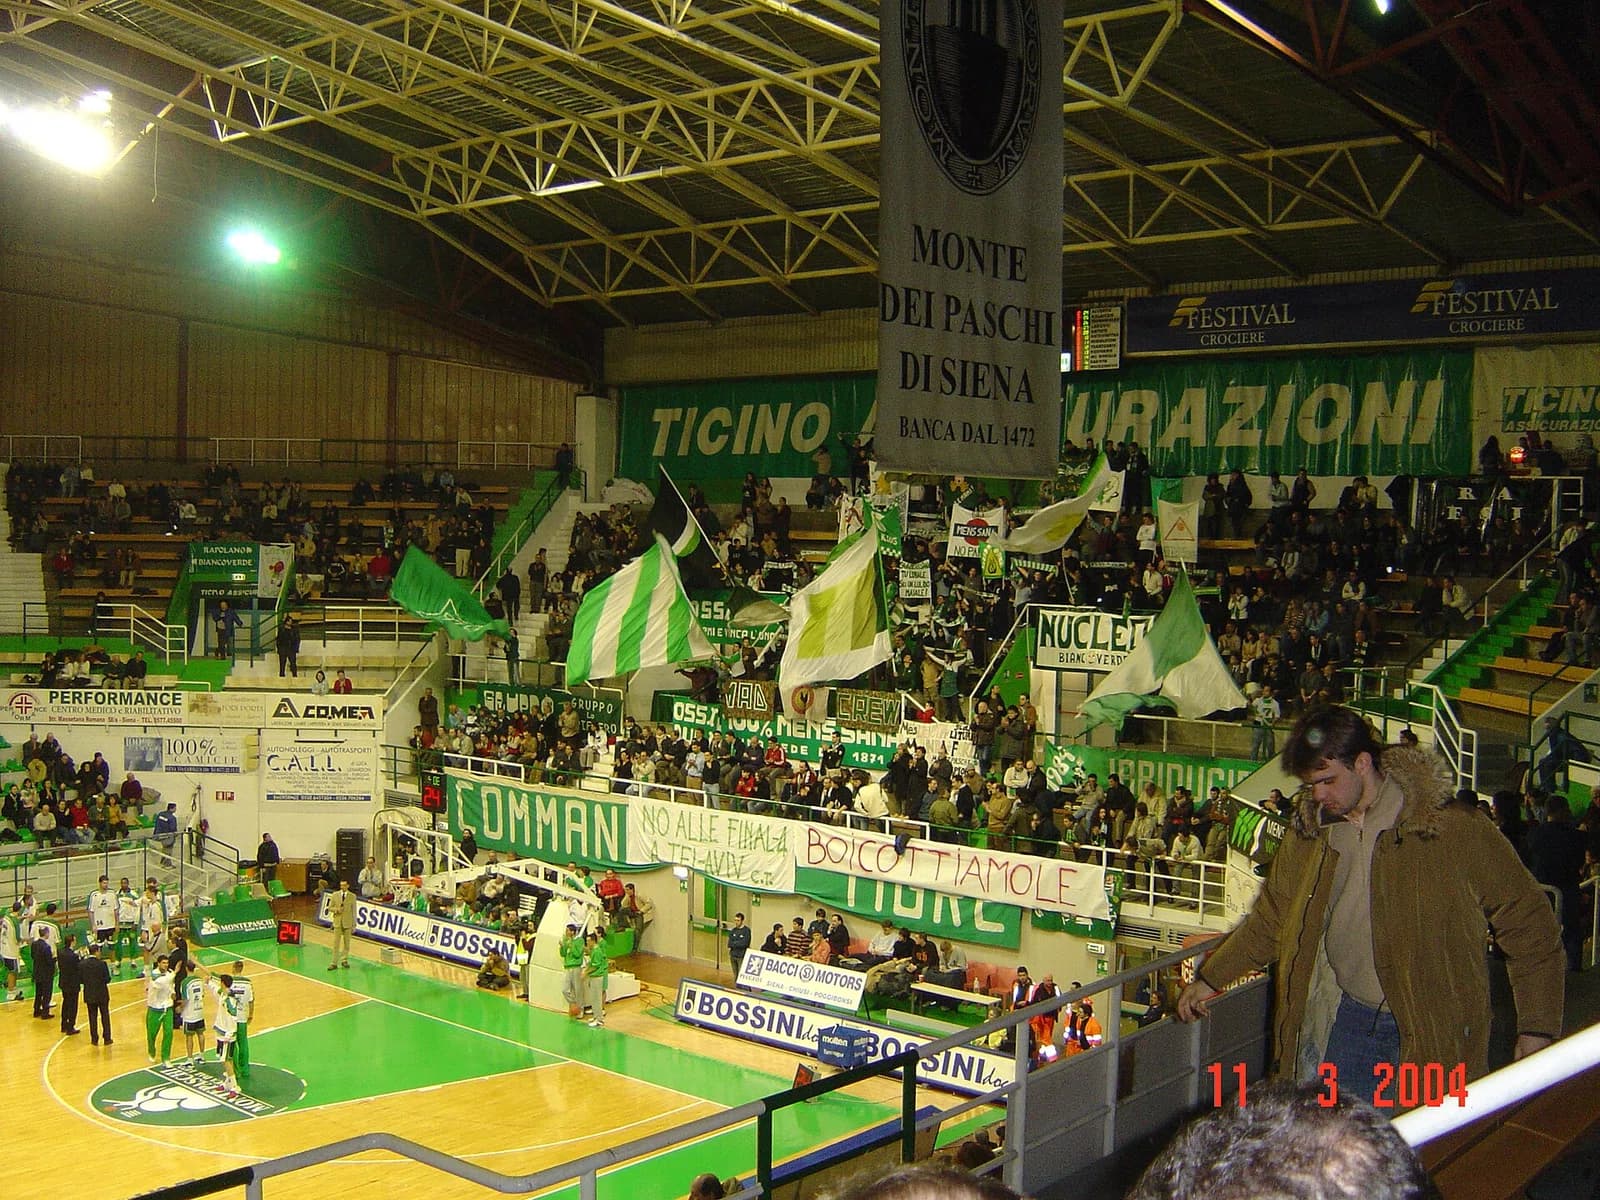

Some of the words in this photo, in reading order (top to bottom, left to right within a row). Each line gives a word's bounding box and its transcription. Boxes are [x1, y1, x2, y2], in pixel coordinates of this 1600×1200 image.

[912, 224, 1027, 283] MONTE
[881, 282, 935, 329] DEI
[944, 294, 1056, 346] PASCHI
[1187, 303, 1296, 329] FESTIVAL
[1432, 287, 1559, 316] FESTIVAL
[1200, 331, 1265, 346] CROCIERE
[1449, 318, 1526, 334] CROCIERE
[900, 351, 933, 393] DI
[939, 356, 1035, 404] SIENA
[1503, 386, 1600, 415] TICIN
[652, 402, 832, 457] TICINO
[1066, 379, 1445, 448] URAZIONI
[900, 416, 956, 443] BANCA
[962, 421, 998, 446] DAL
[1002, 426, 1036, 448] 1472
[49, 691, 182, 705] PERFORMANCE
[51, 705, 83, 715] CENTRO
[572, 698, 614, 714] GRUPPO
[836, 693, 900, 726] CREW
[776, 714, 836, 742] MENS
[166, 738, 217, 756] 100%
[174, 755, 238, 765] CAMICIE
[423, 785, 441, 807] 24
[455, 780, 619, 862] COMMAN
[642, 804, 670, 837] NO
[675, 809, 719, 844] ALLE
[651, 840, 660, 863] A
[806, 826, 1078, 907] BOICOTTIAMOLE
[280, 922, 299, 941] 24
[356, 906, 405, 936] SSINI
[440, 925, 517, 966] BOSSIN
[765, 958, 799, 978] BACCI
[815, 969, 863, 992] MOTORS
[698, 992, 806, 1041] BOSSINI
